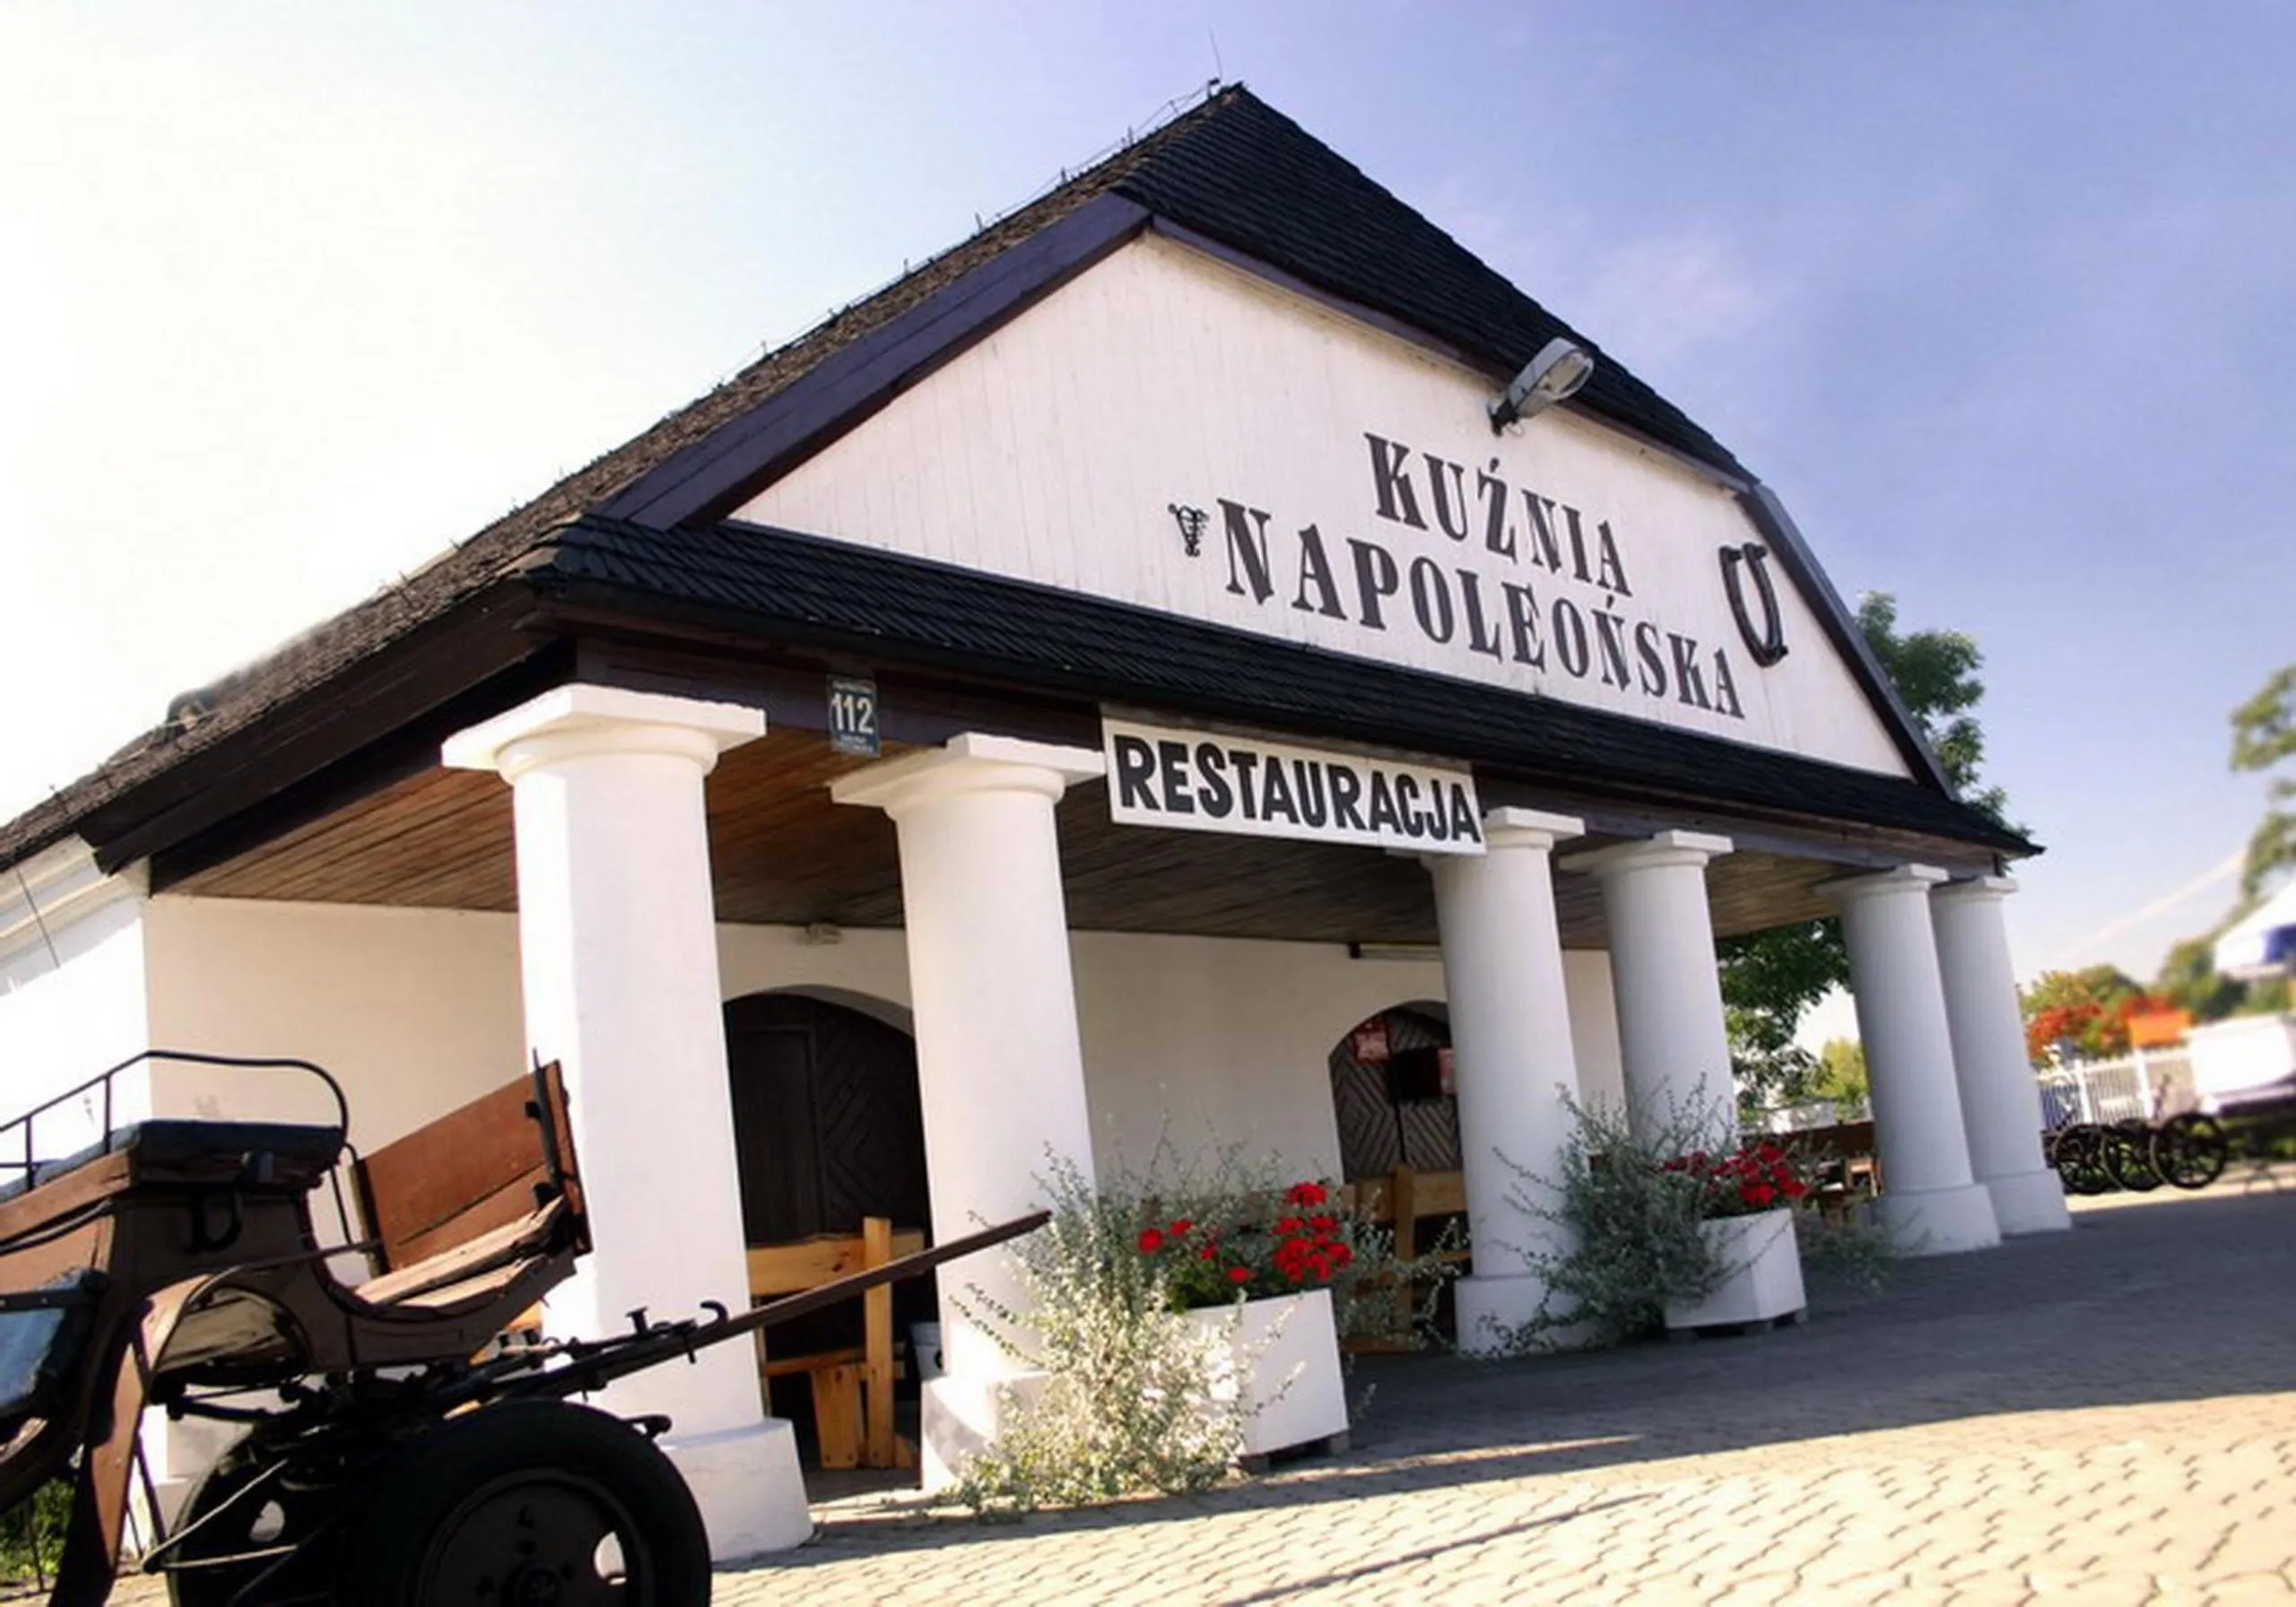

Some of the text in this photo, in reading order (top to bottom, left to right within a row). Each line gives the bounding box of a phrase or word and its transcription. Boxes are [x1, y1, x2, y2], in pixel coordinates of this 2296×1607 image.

[1363, 431, 1633, 598] KUŹNIA
[1215, 496, 1746, 720] NAPOLEOŃSKA
[831, 691, 874, 734] 112
[1112, 734, 1482, 844] RESTAURACJA
